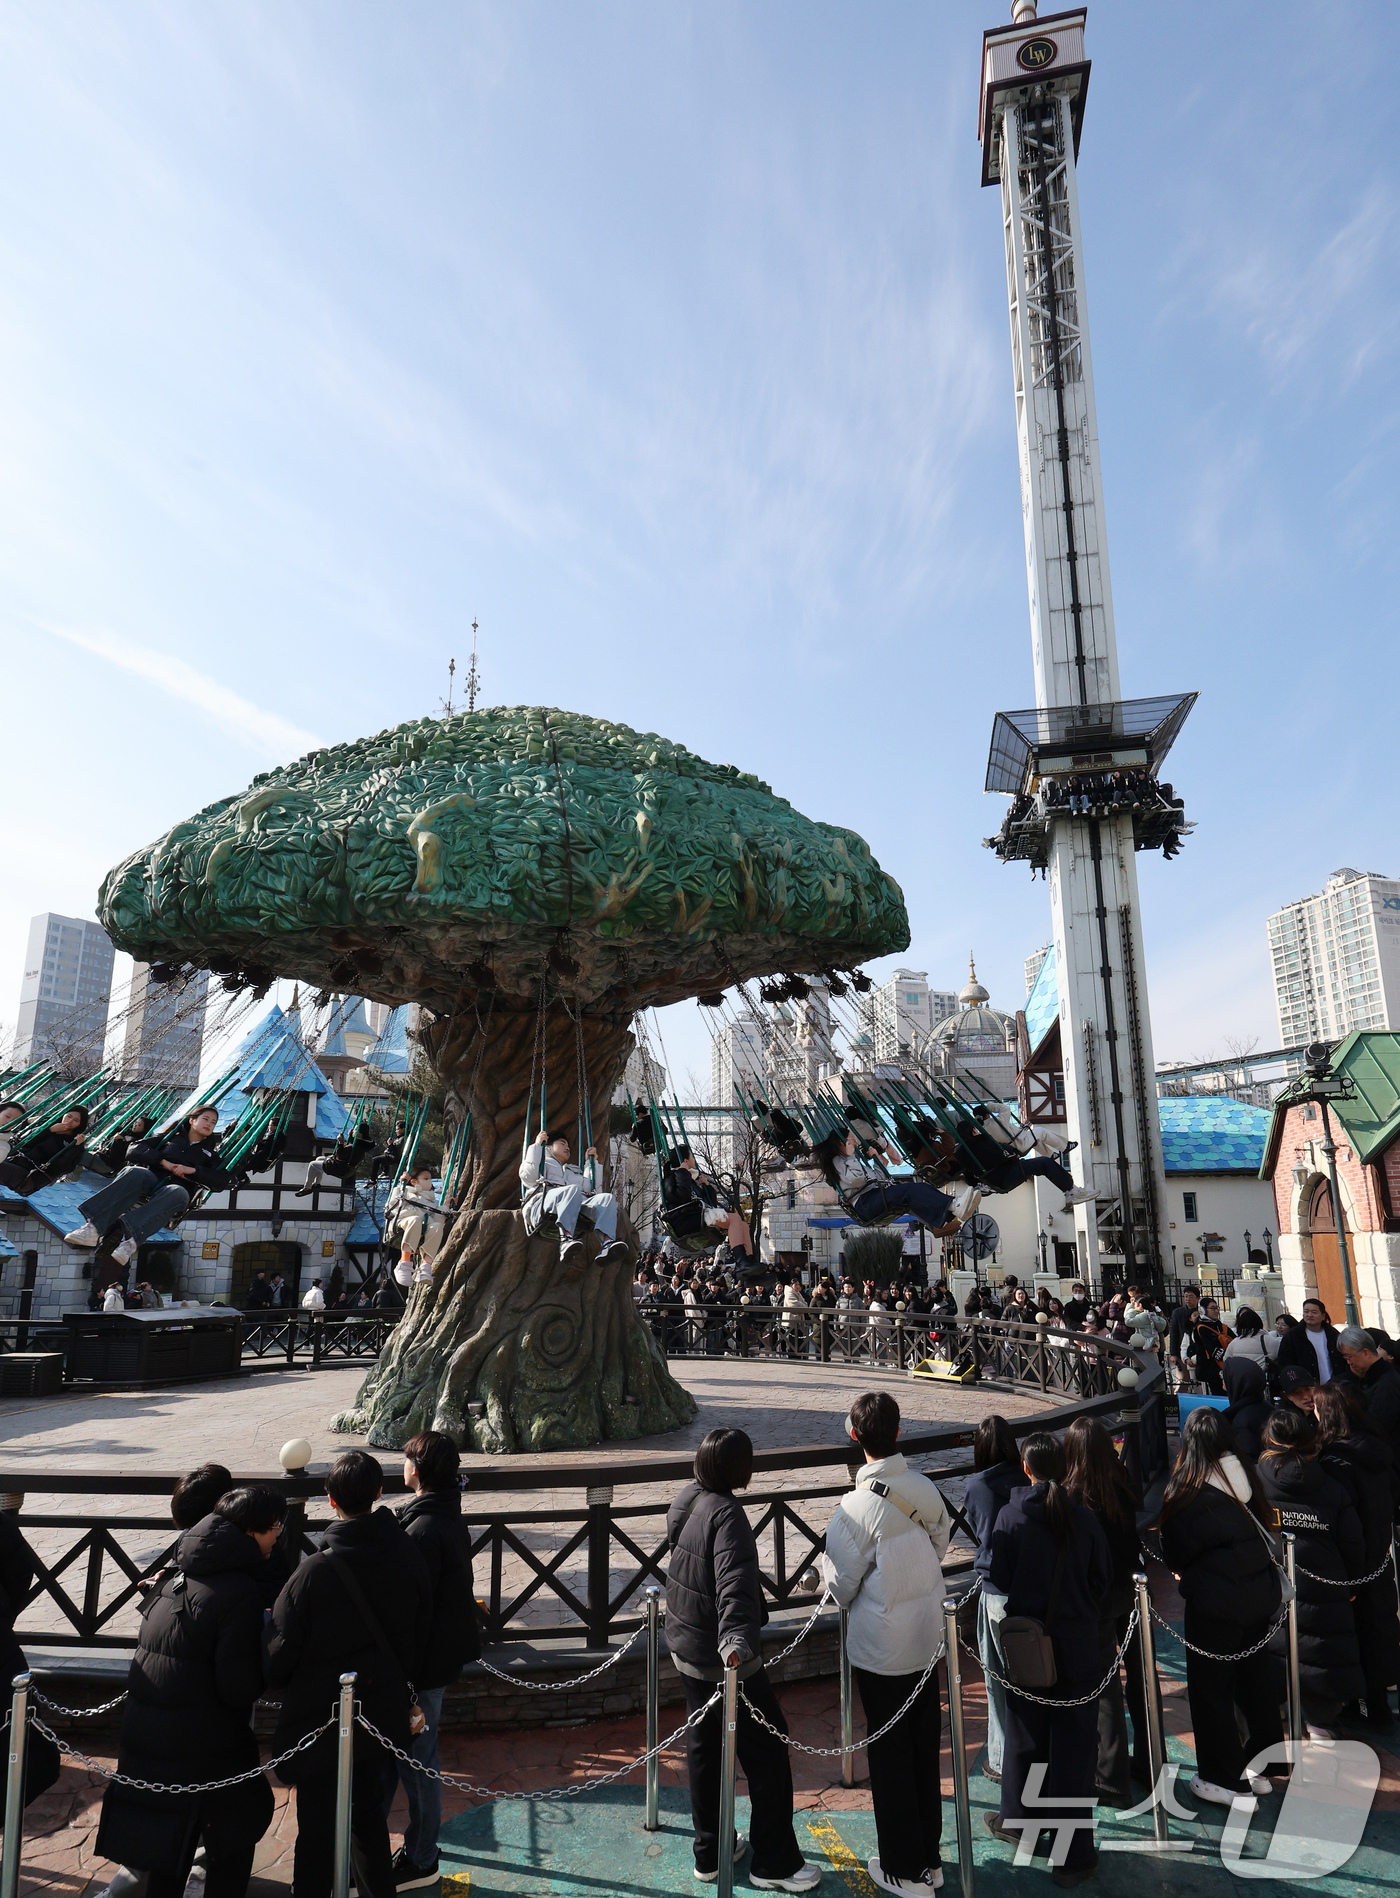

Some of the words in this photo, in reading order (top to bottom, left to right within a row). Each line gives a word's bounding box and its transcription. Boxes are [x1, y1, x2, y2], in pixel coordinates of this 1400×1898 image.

[1028, 45, 1047, 64] LW
[1282, 1510, 1320, 1523] NATIONAL
[1282, 1518, 1330, 1531] GEOGRAPHIC
